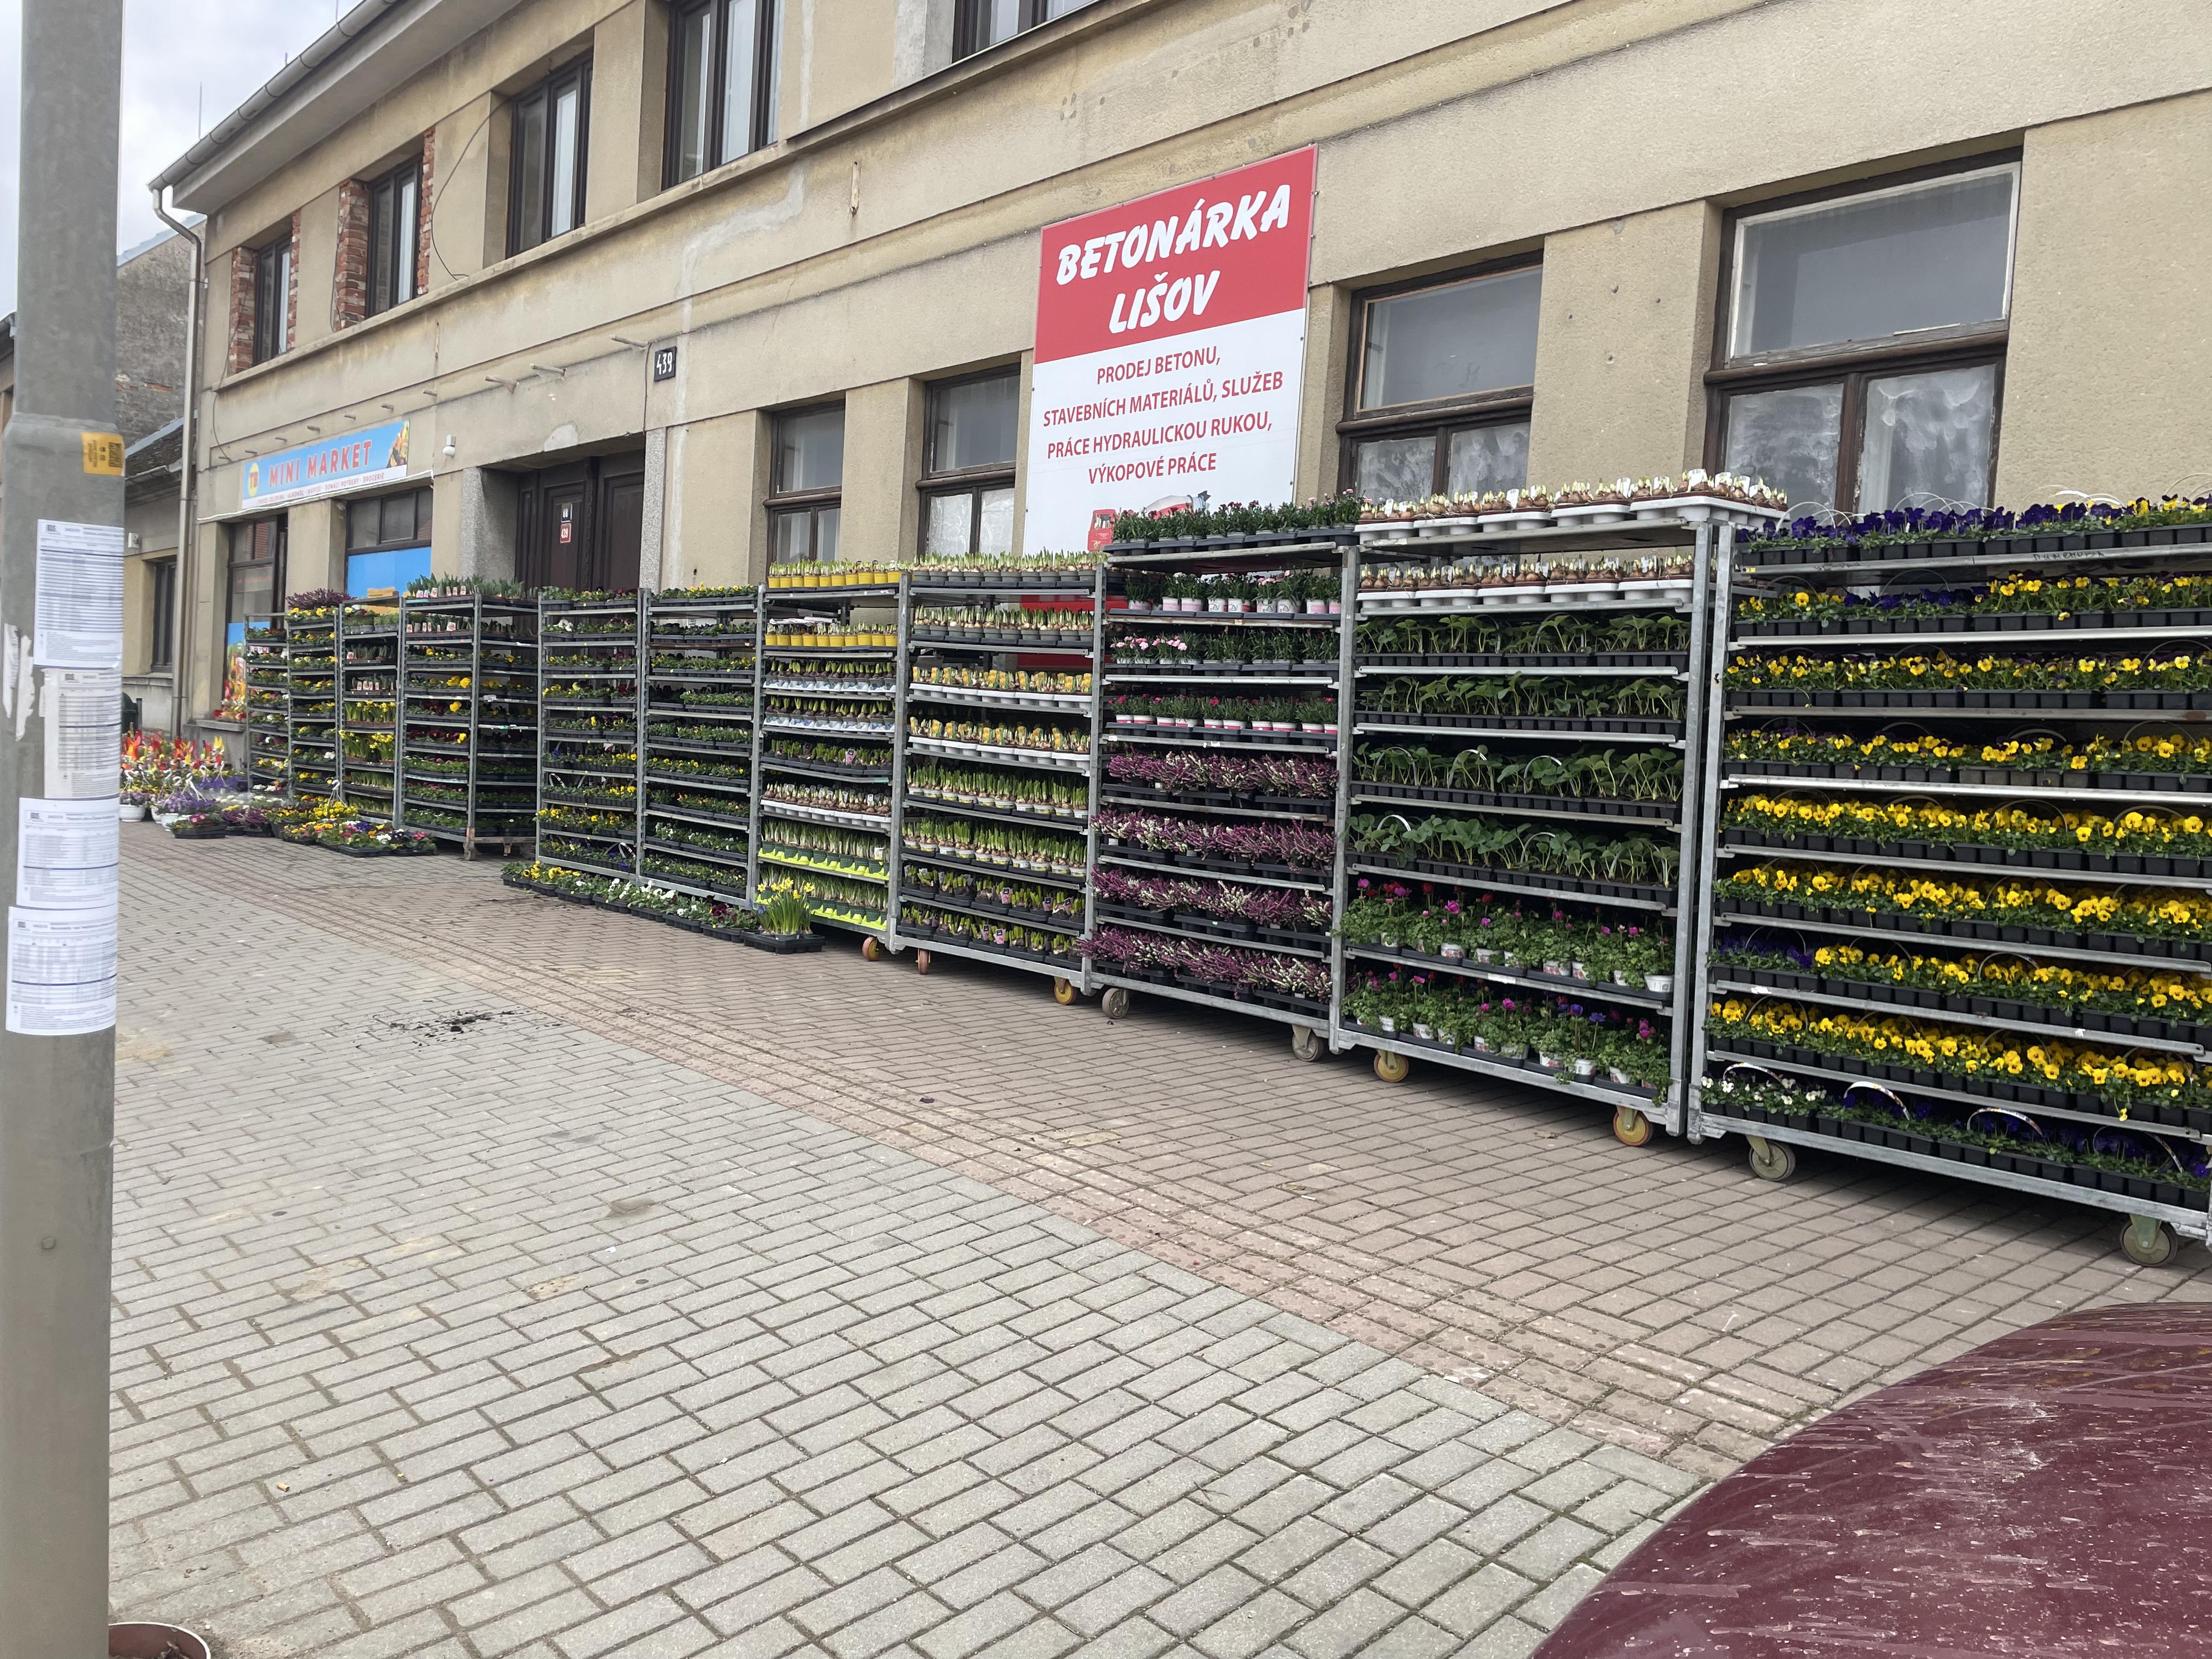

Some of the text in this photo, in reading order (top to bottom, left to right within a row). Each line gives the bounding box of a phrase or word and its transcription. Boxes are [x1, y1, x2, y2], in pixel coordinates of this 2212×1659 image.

[1056, 185, 1291, 285] BETONÁRKA
[1109, 270, 1220, 333] LIŠOV
[656, 352, 672, 375] 439
[1097, 346, 1221, 384] PRODEJ BETONU,
[1044, 371, 1283, 427] STAVEBNÍCH MATERIÁLŮ, SLUŽEB
[1047, 411, 1272, 458] PRÁCE HYDRAULICKOU RUKOU,
[249, 471, 258, 489] TB
[269, 440, 372, 487] MINI MARKET
[363, 472, 385, 483] DROGERIE
[1089, 451, 1217, 484] VÝKOPOVÉ PRÁCE
